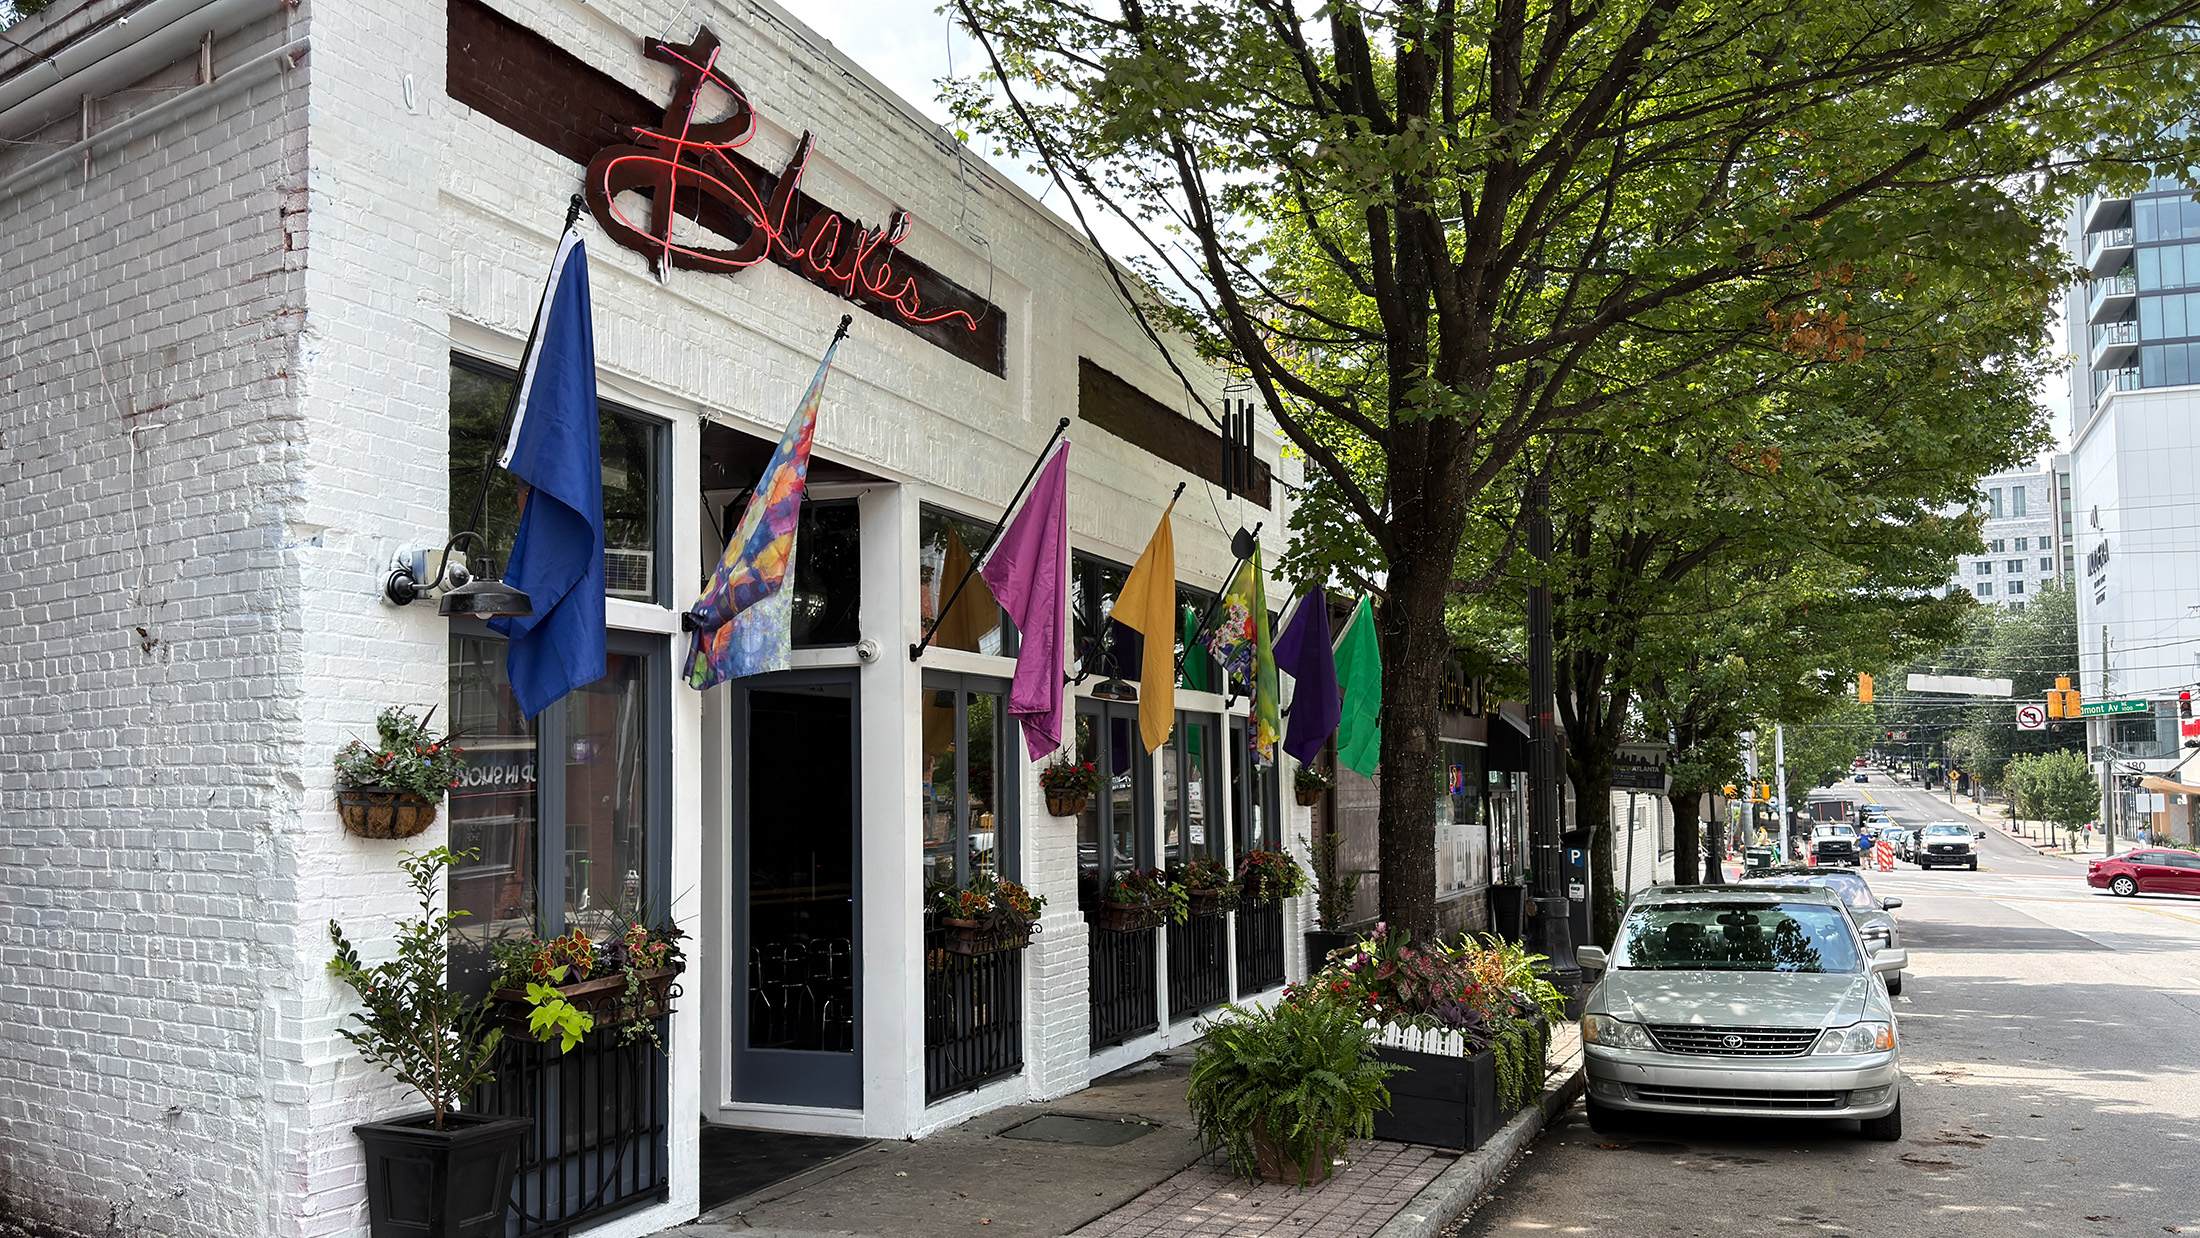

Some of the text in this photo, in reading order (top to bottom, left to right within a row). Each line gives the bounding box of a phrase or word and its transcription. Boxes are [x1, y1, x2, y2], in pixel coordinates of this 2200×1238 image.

[585, 25, 978, 331] Blake's
[2081, 703, 2119, 714] dmont Av
[1571, 849, 1581, 864] P
